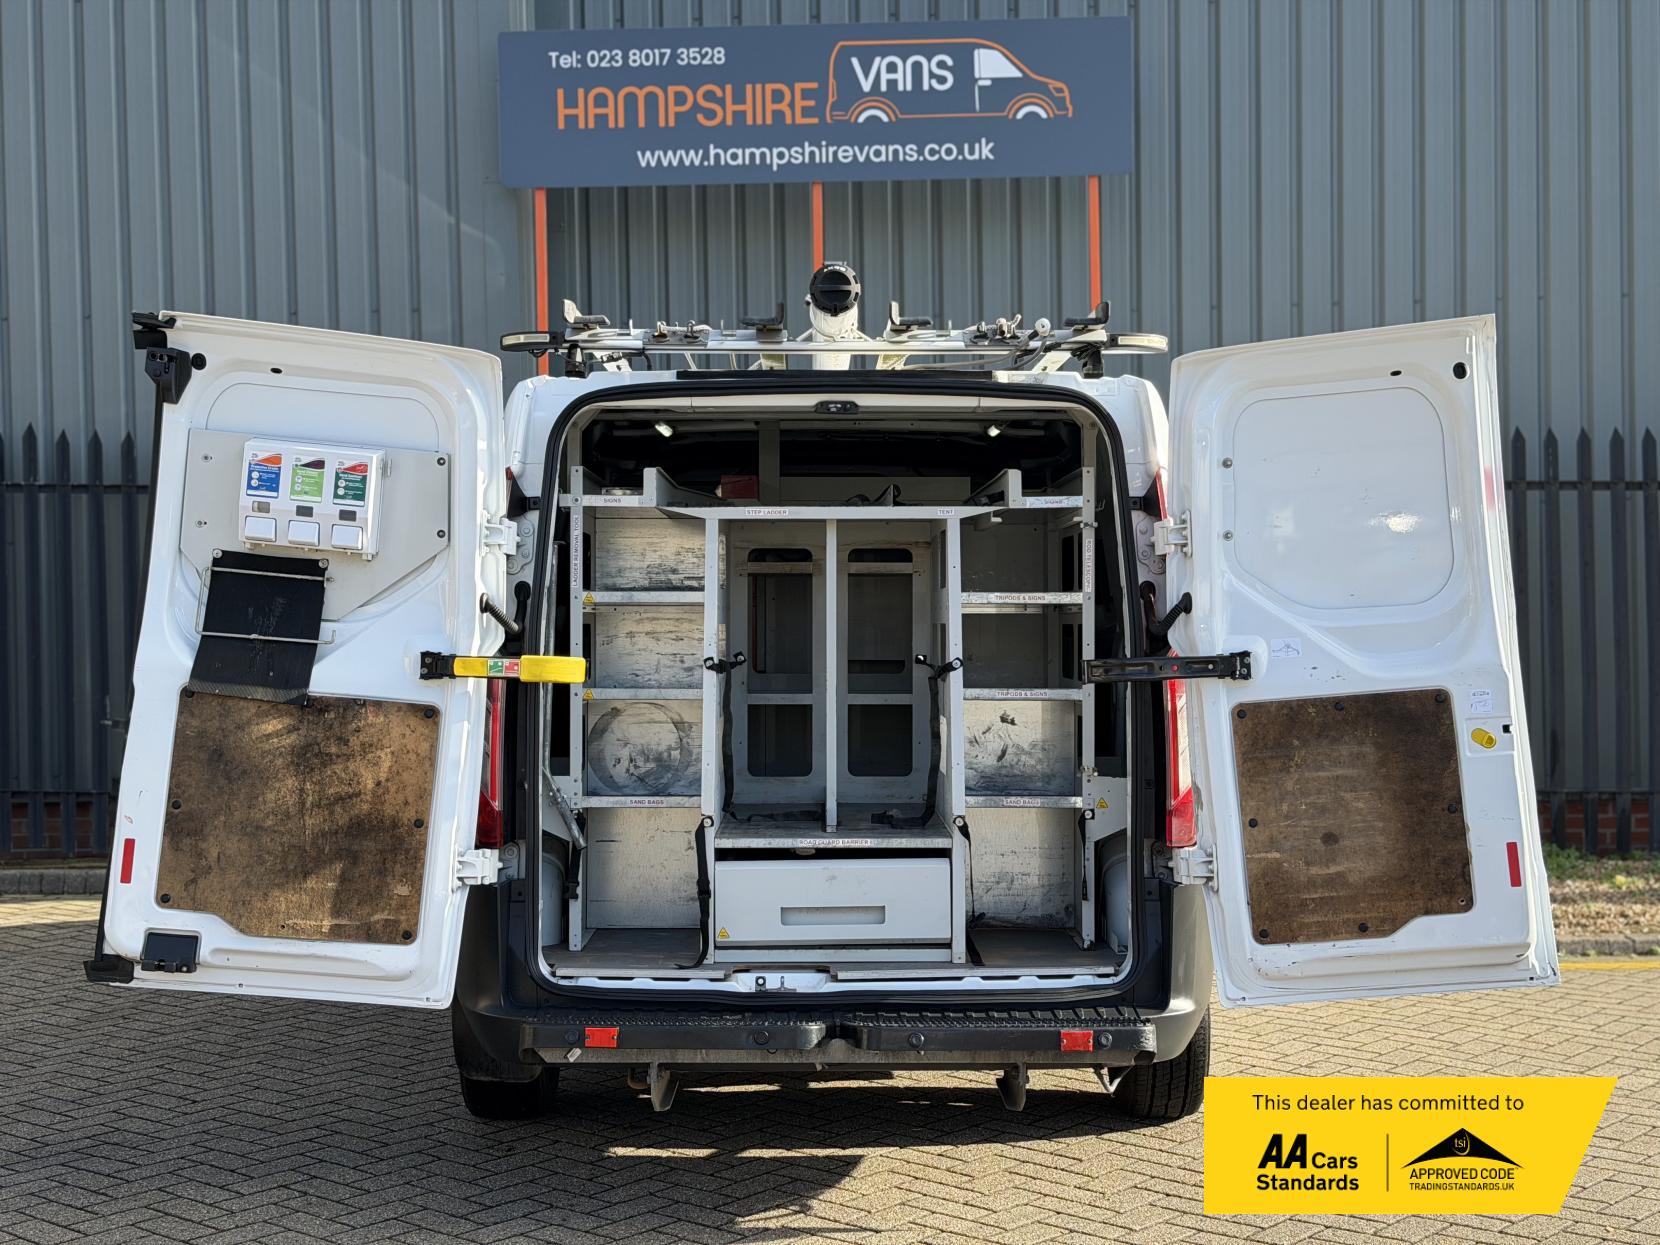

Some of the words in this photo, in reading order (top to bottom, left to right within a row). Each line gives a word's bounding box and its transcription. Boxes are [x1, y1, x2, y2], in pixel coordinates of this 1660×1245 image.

[548, 50, 582, 69] Tel:
[586, 50, 623, 68] 023
[628, 48, 671, 67] 8017
[676, 46, 726, 66] 3528
[850, 54, 954, 93] VANS
[557, 81, 820, 130] HAMPSHIRE
[637, 138, 994, 171] www.hampshirevans.co.uk
